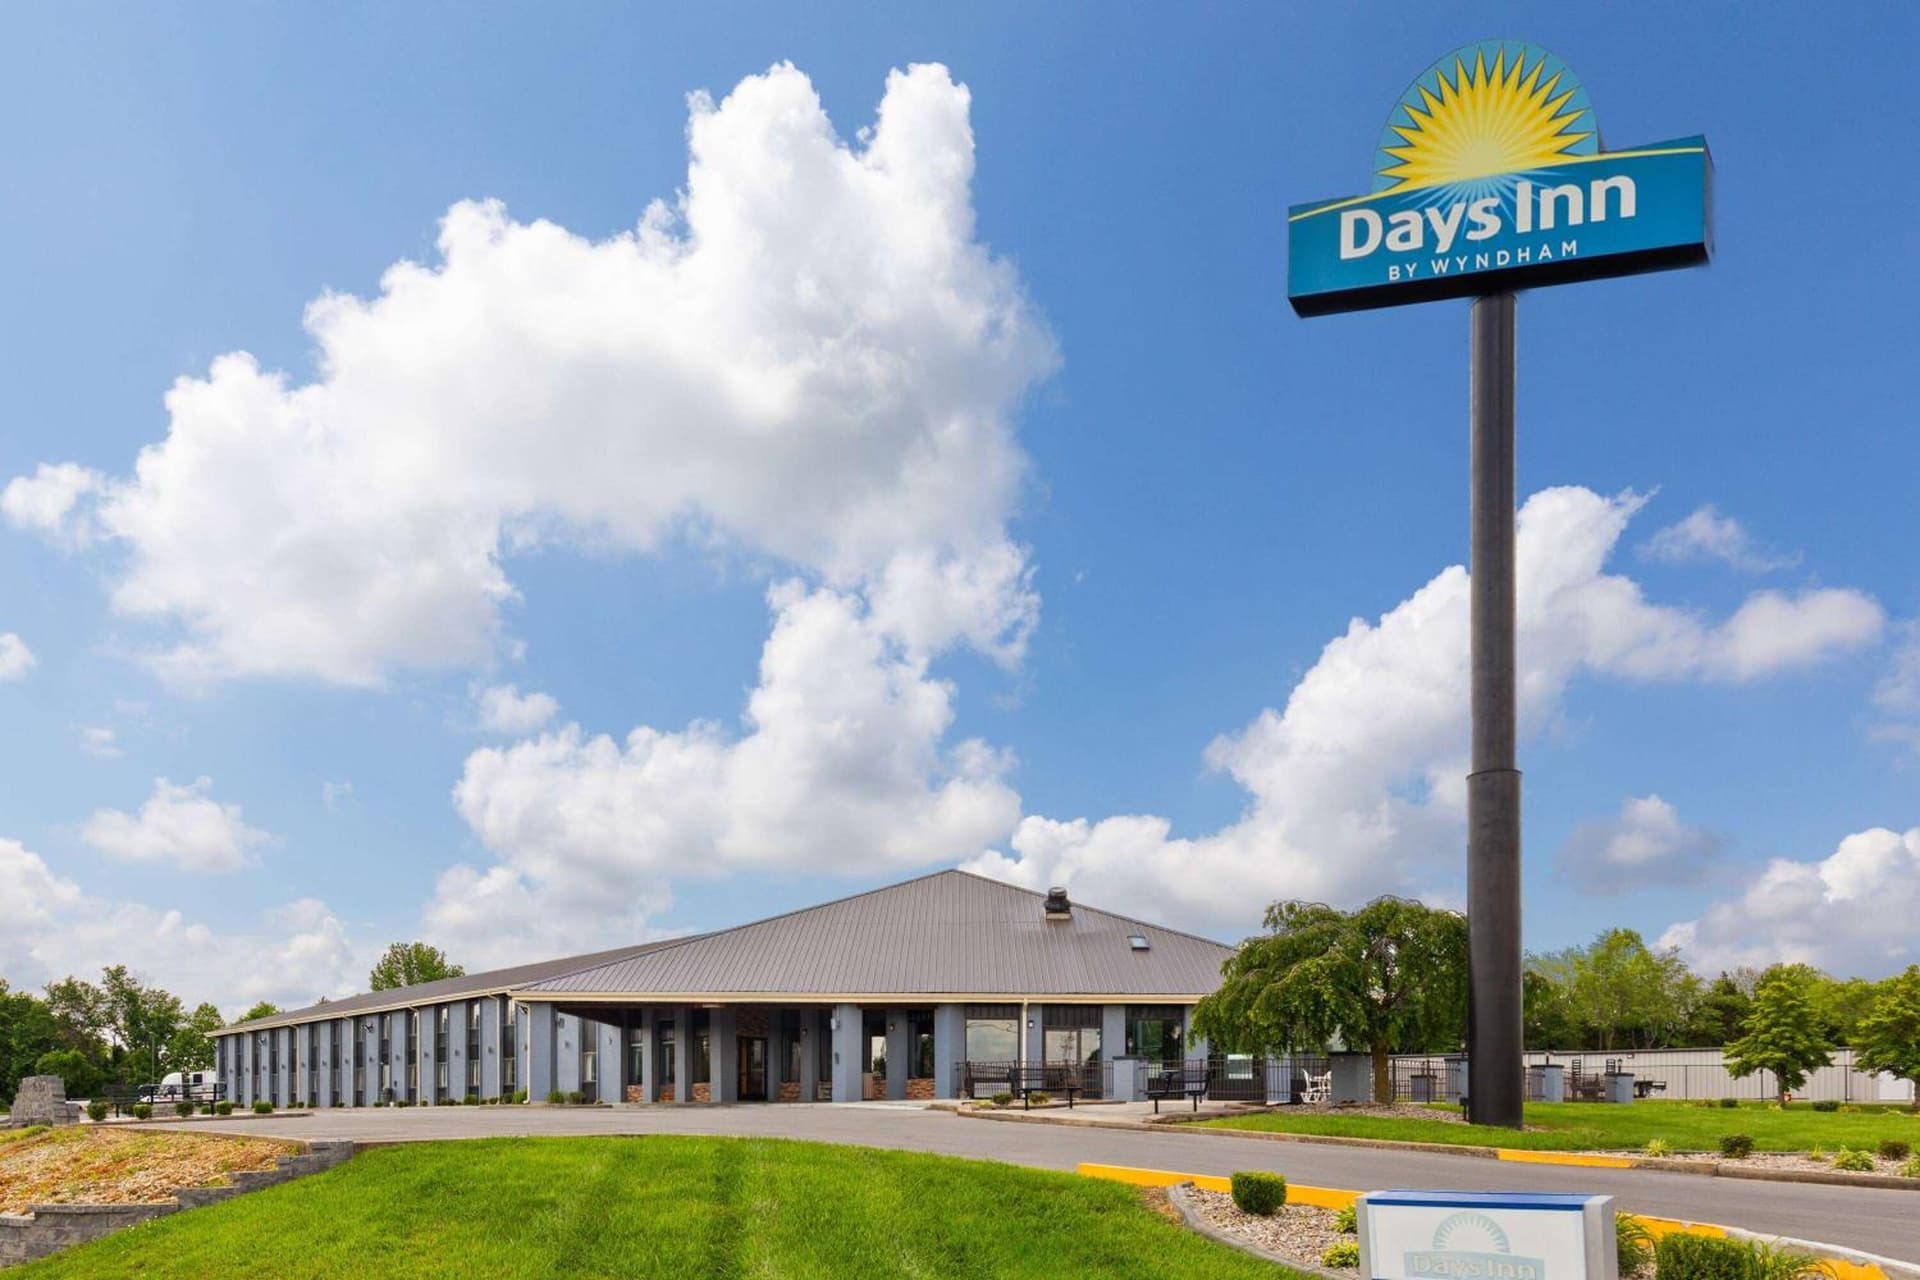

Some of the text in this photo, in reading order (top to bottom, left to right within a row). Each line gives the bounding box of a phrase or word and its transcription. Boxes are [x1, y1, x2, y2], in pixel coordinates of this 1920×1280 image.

[1340, 175, 1636, 260] Days Inn
[1388, 240, 1578, 281] BY WYNDHAM
[1413, 1255, 1536, 1280] Days Inn
